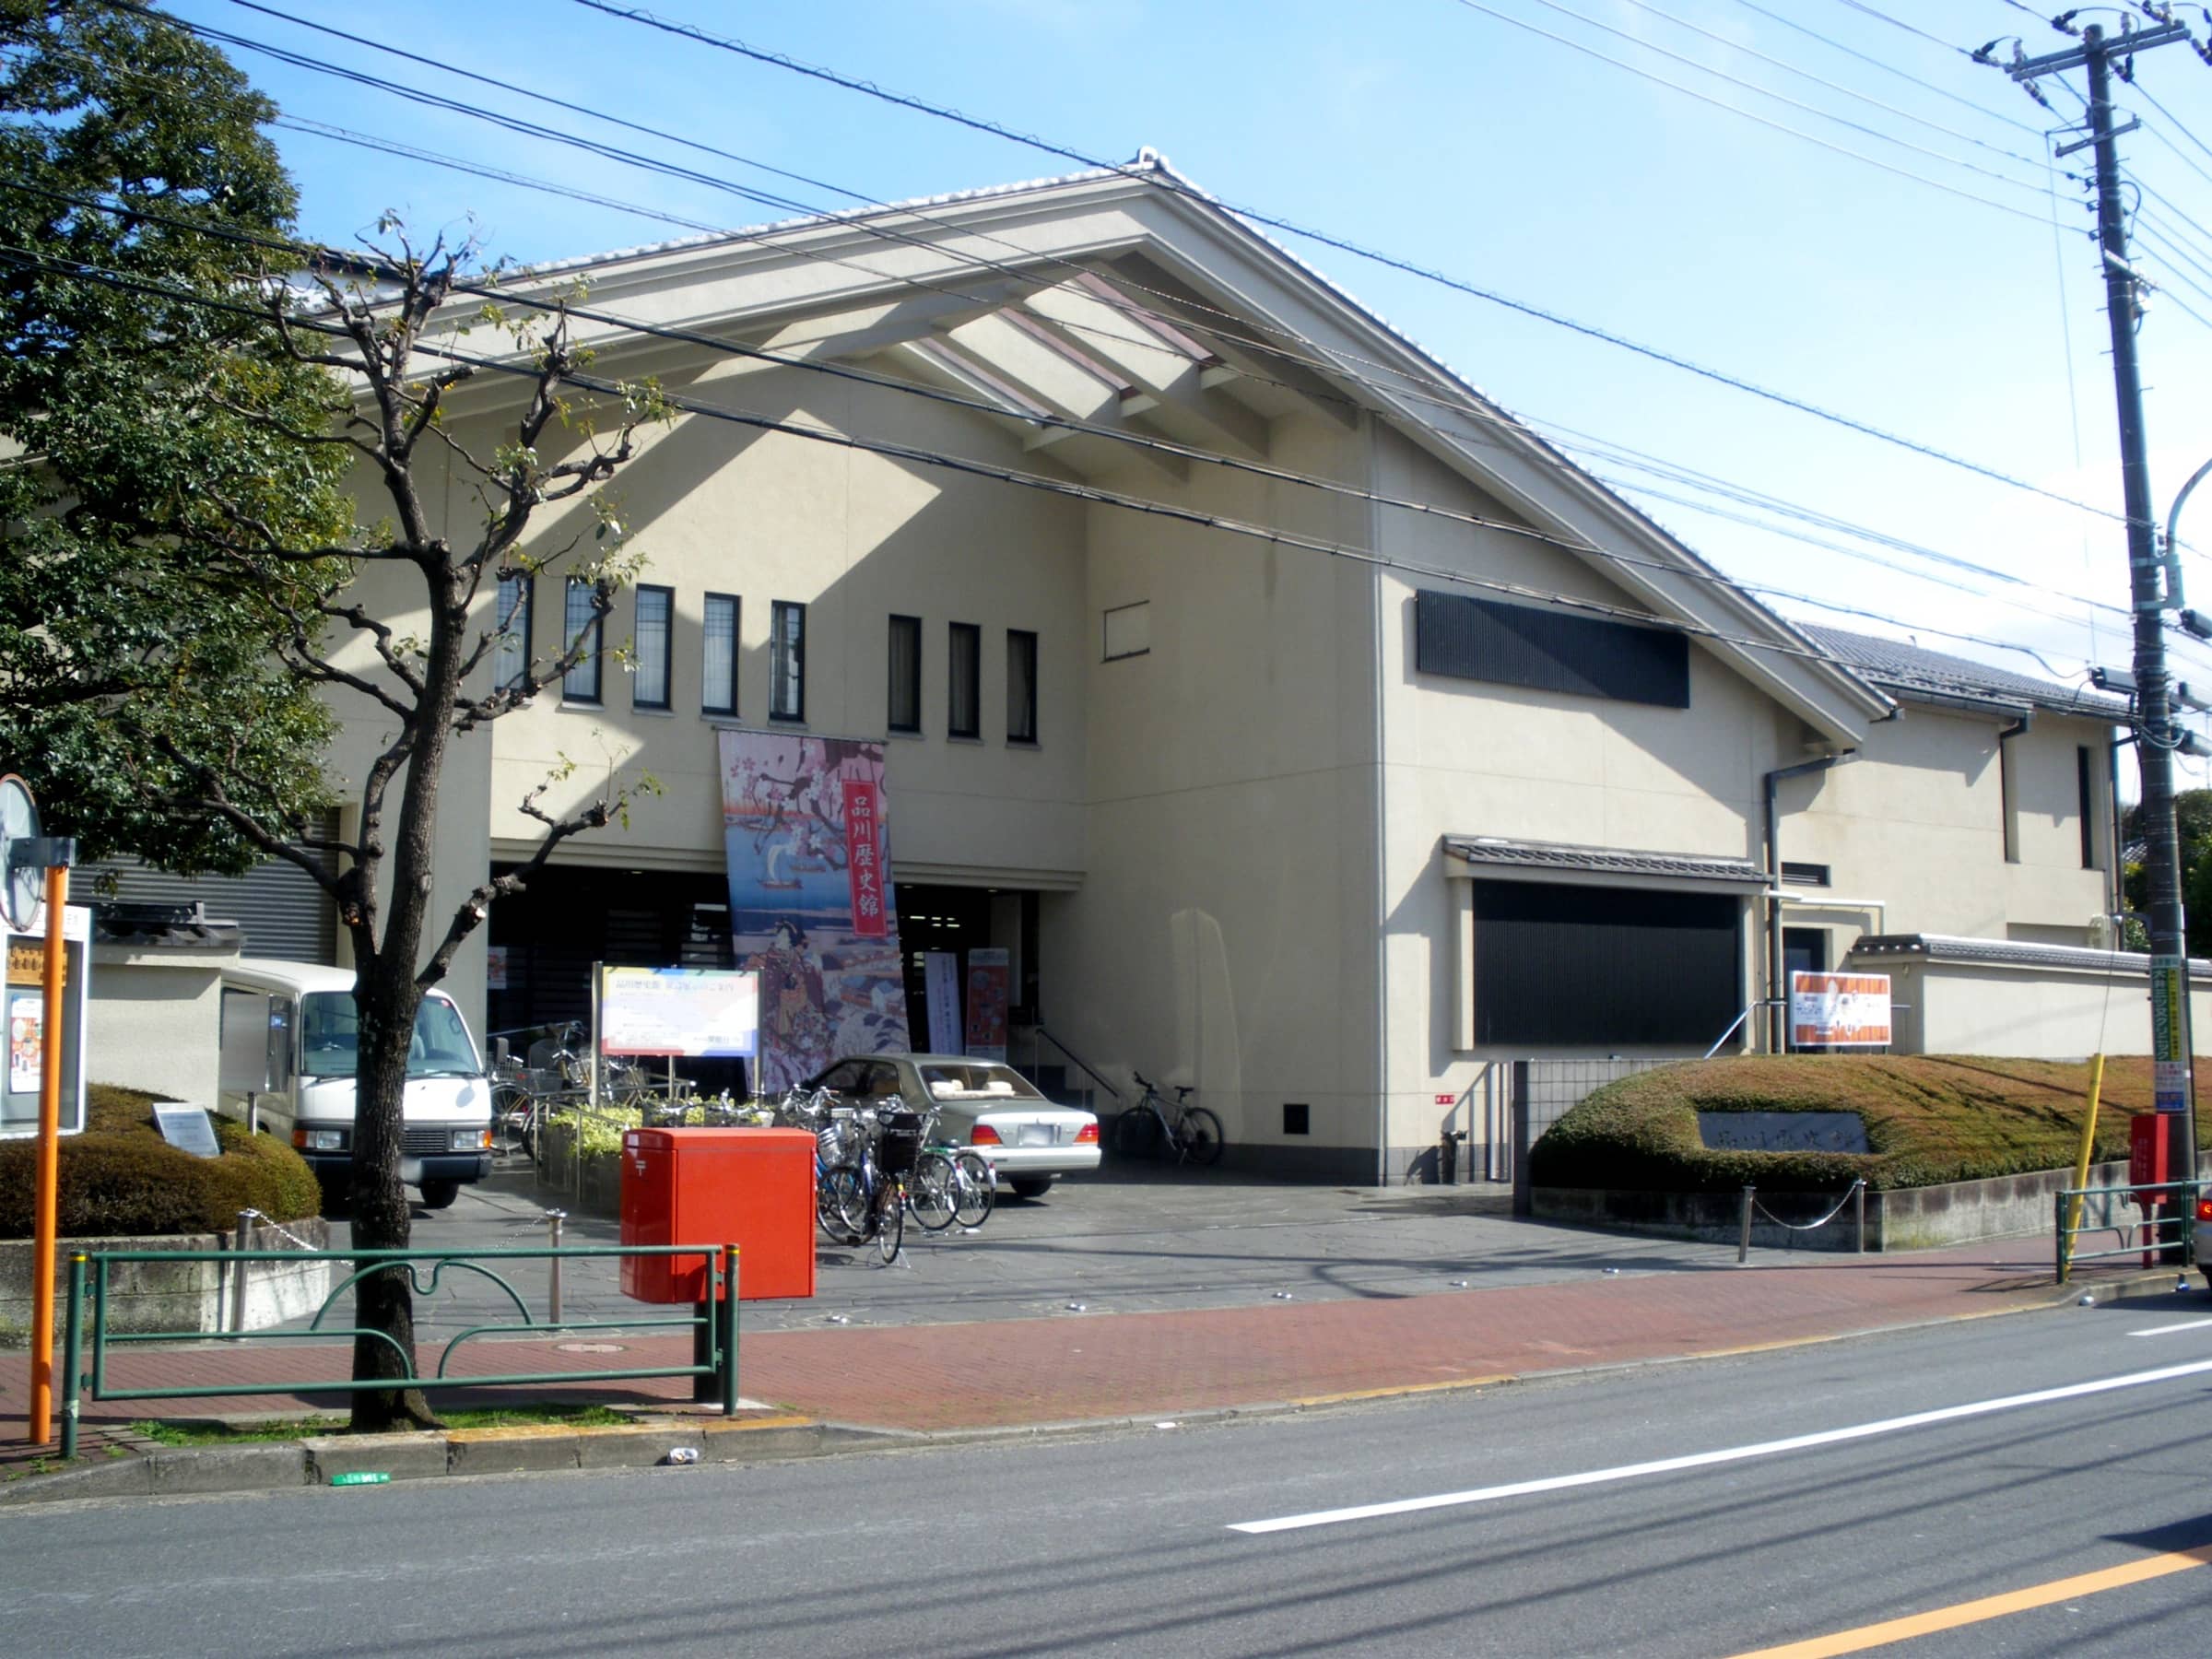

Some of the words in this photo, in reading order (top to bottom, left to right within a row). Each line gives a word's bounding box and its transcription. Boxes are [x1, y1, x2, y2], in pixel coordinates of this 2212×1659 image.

[850, 795, 879, 917] 品川歴史館
